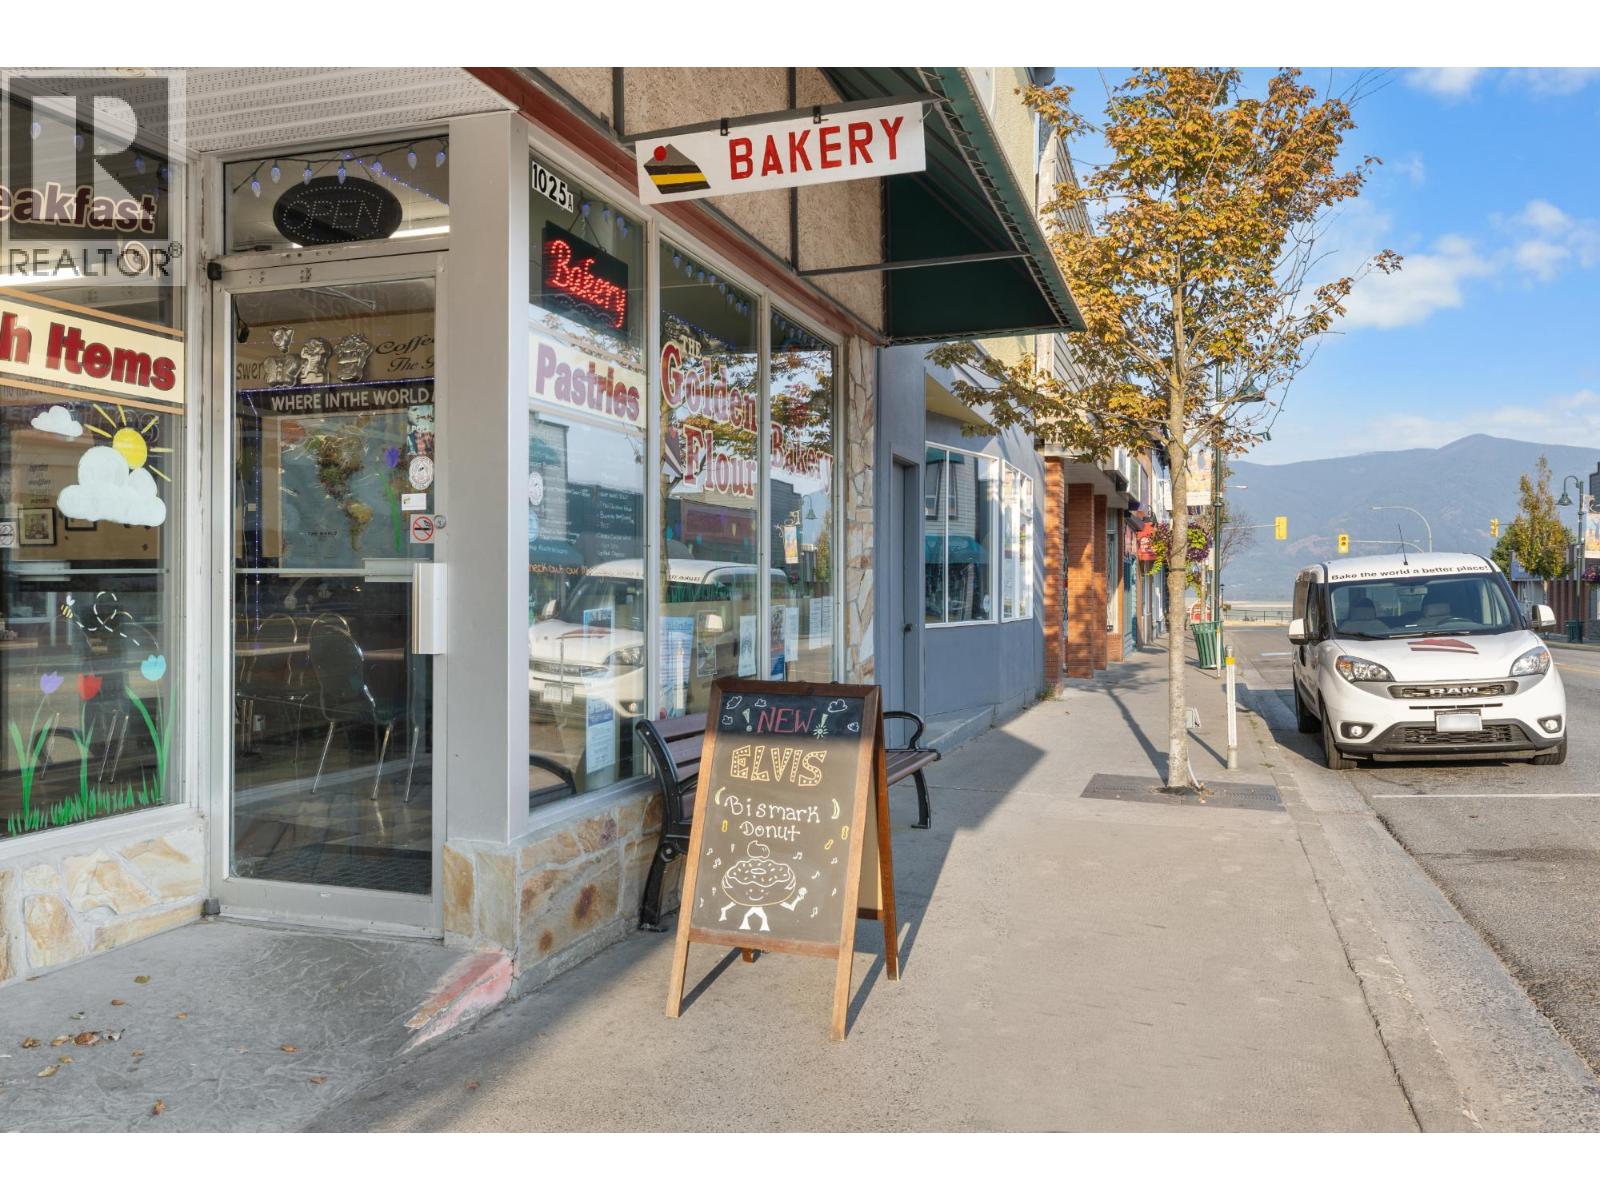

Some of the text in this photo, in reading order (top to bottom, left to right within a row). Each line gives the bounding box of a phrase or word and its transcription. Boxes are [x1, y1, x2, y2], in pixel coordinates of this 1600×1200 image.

[728, 116, 904, 180] BAKERY
[283, 200, 384, 230] OPEN
[550, 239, 627, 329] Bakery
[46, 321, 177, 391] Items
[375, 334, 434, 356] Coffe
[682, 335, 702, 359] THE
[387, 357, 419, 373] The
[535, 343, 640, 422] Pastries
[660, 342, 758, 434] Golden
[271, 393, 321, 411] WHERE
[373, 388, 429, 405] WORLD
[683, 424, 758, 498] Flour
[770, 420, 833, 495] Bakery
[1380, 568, 1410, 577] world
[1429, 687, 1478, 695] RAM
[729, 745, 827, 786] ELVIS
[724, 795, 820, 824] Bismark
[739, 821, 801, 842] Donut
